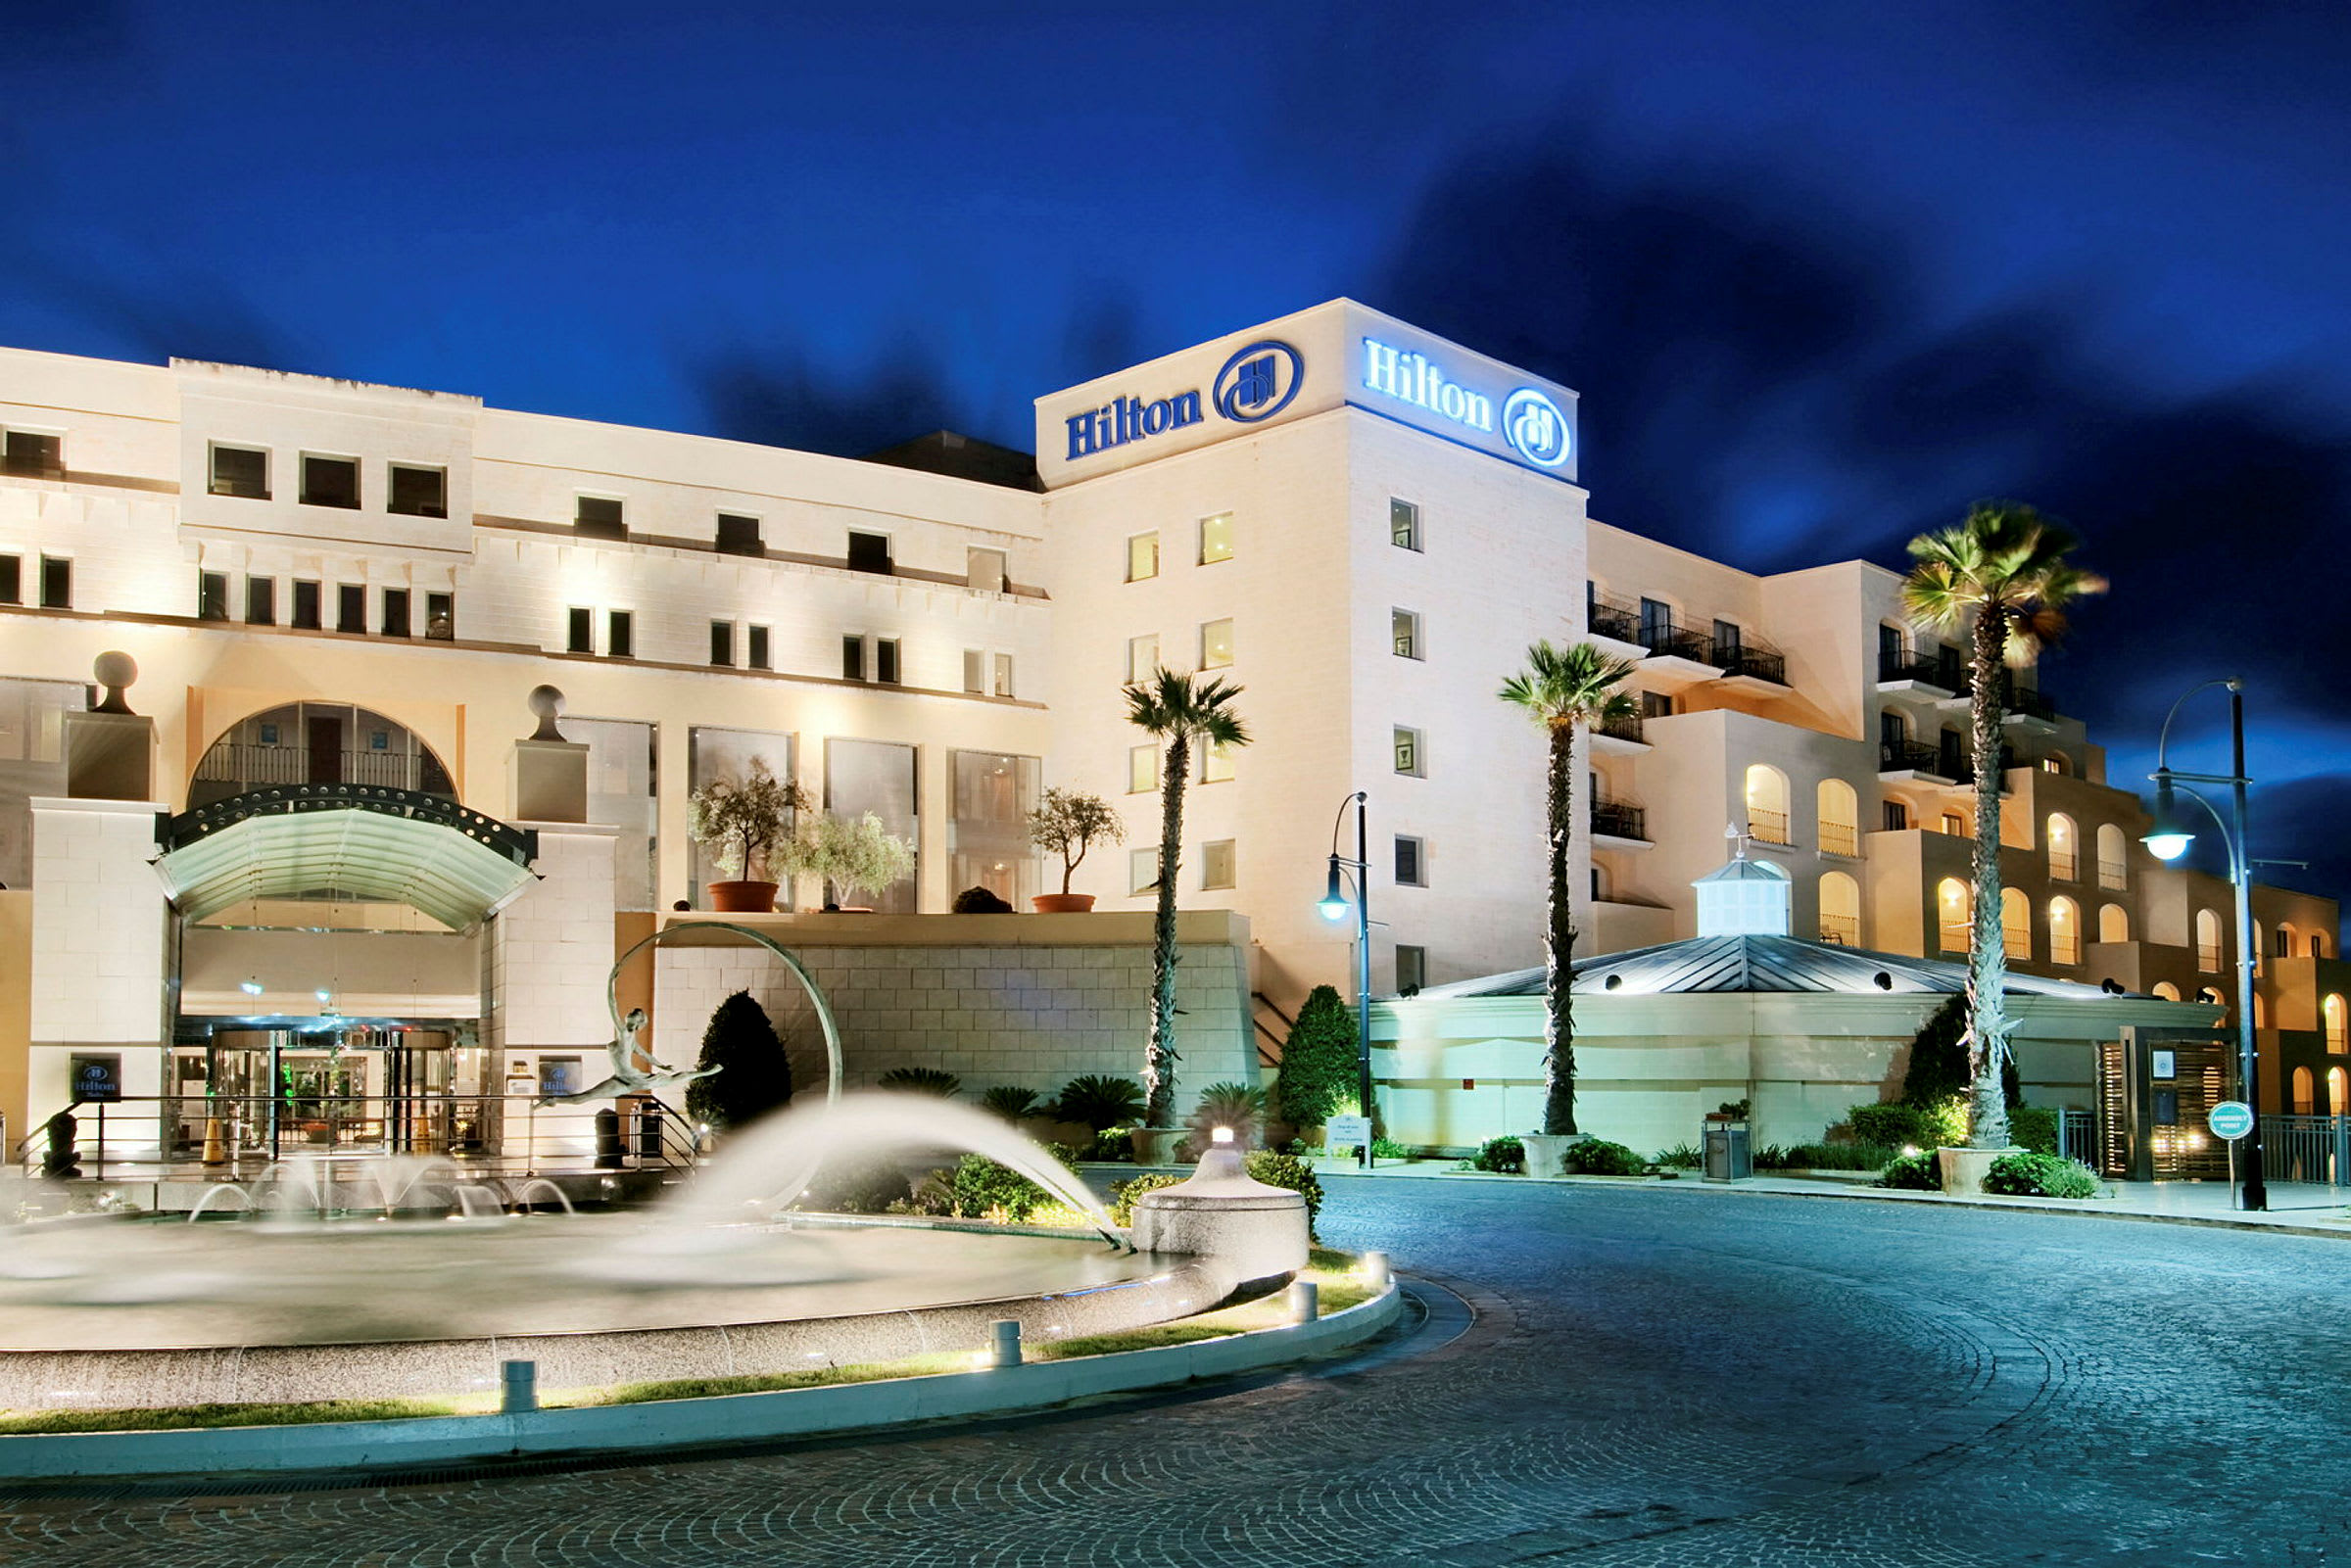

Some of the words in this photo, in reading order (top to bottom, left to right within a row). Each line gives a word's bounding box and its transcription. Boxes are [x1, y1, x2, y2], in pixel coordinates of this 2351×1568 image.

[1363, 337, 1493, 432] Hilton
[1065, 390, 1204, 461] Hilton
[75, 1080, 116, 1091] Hilton
